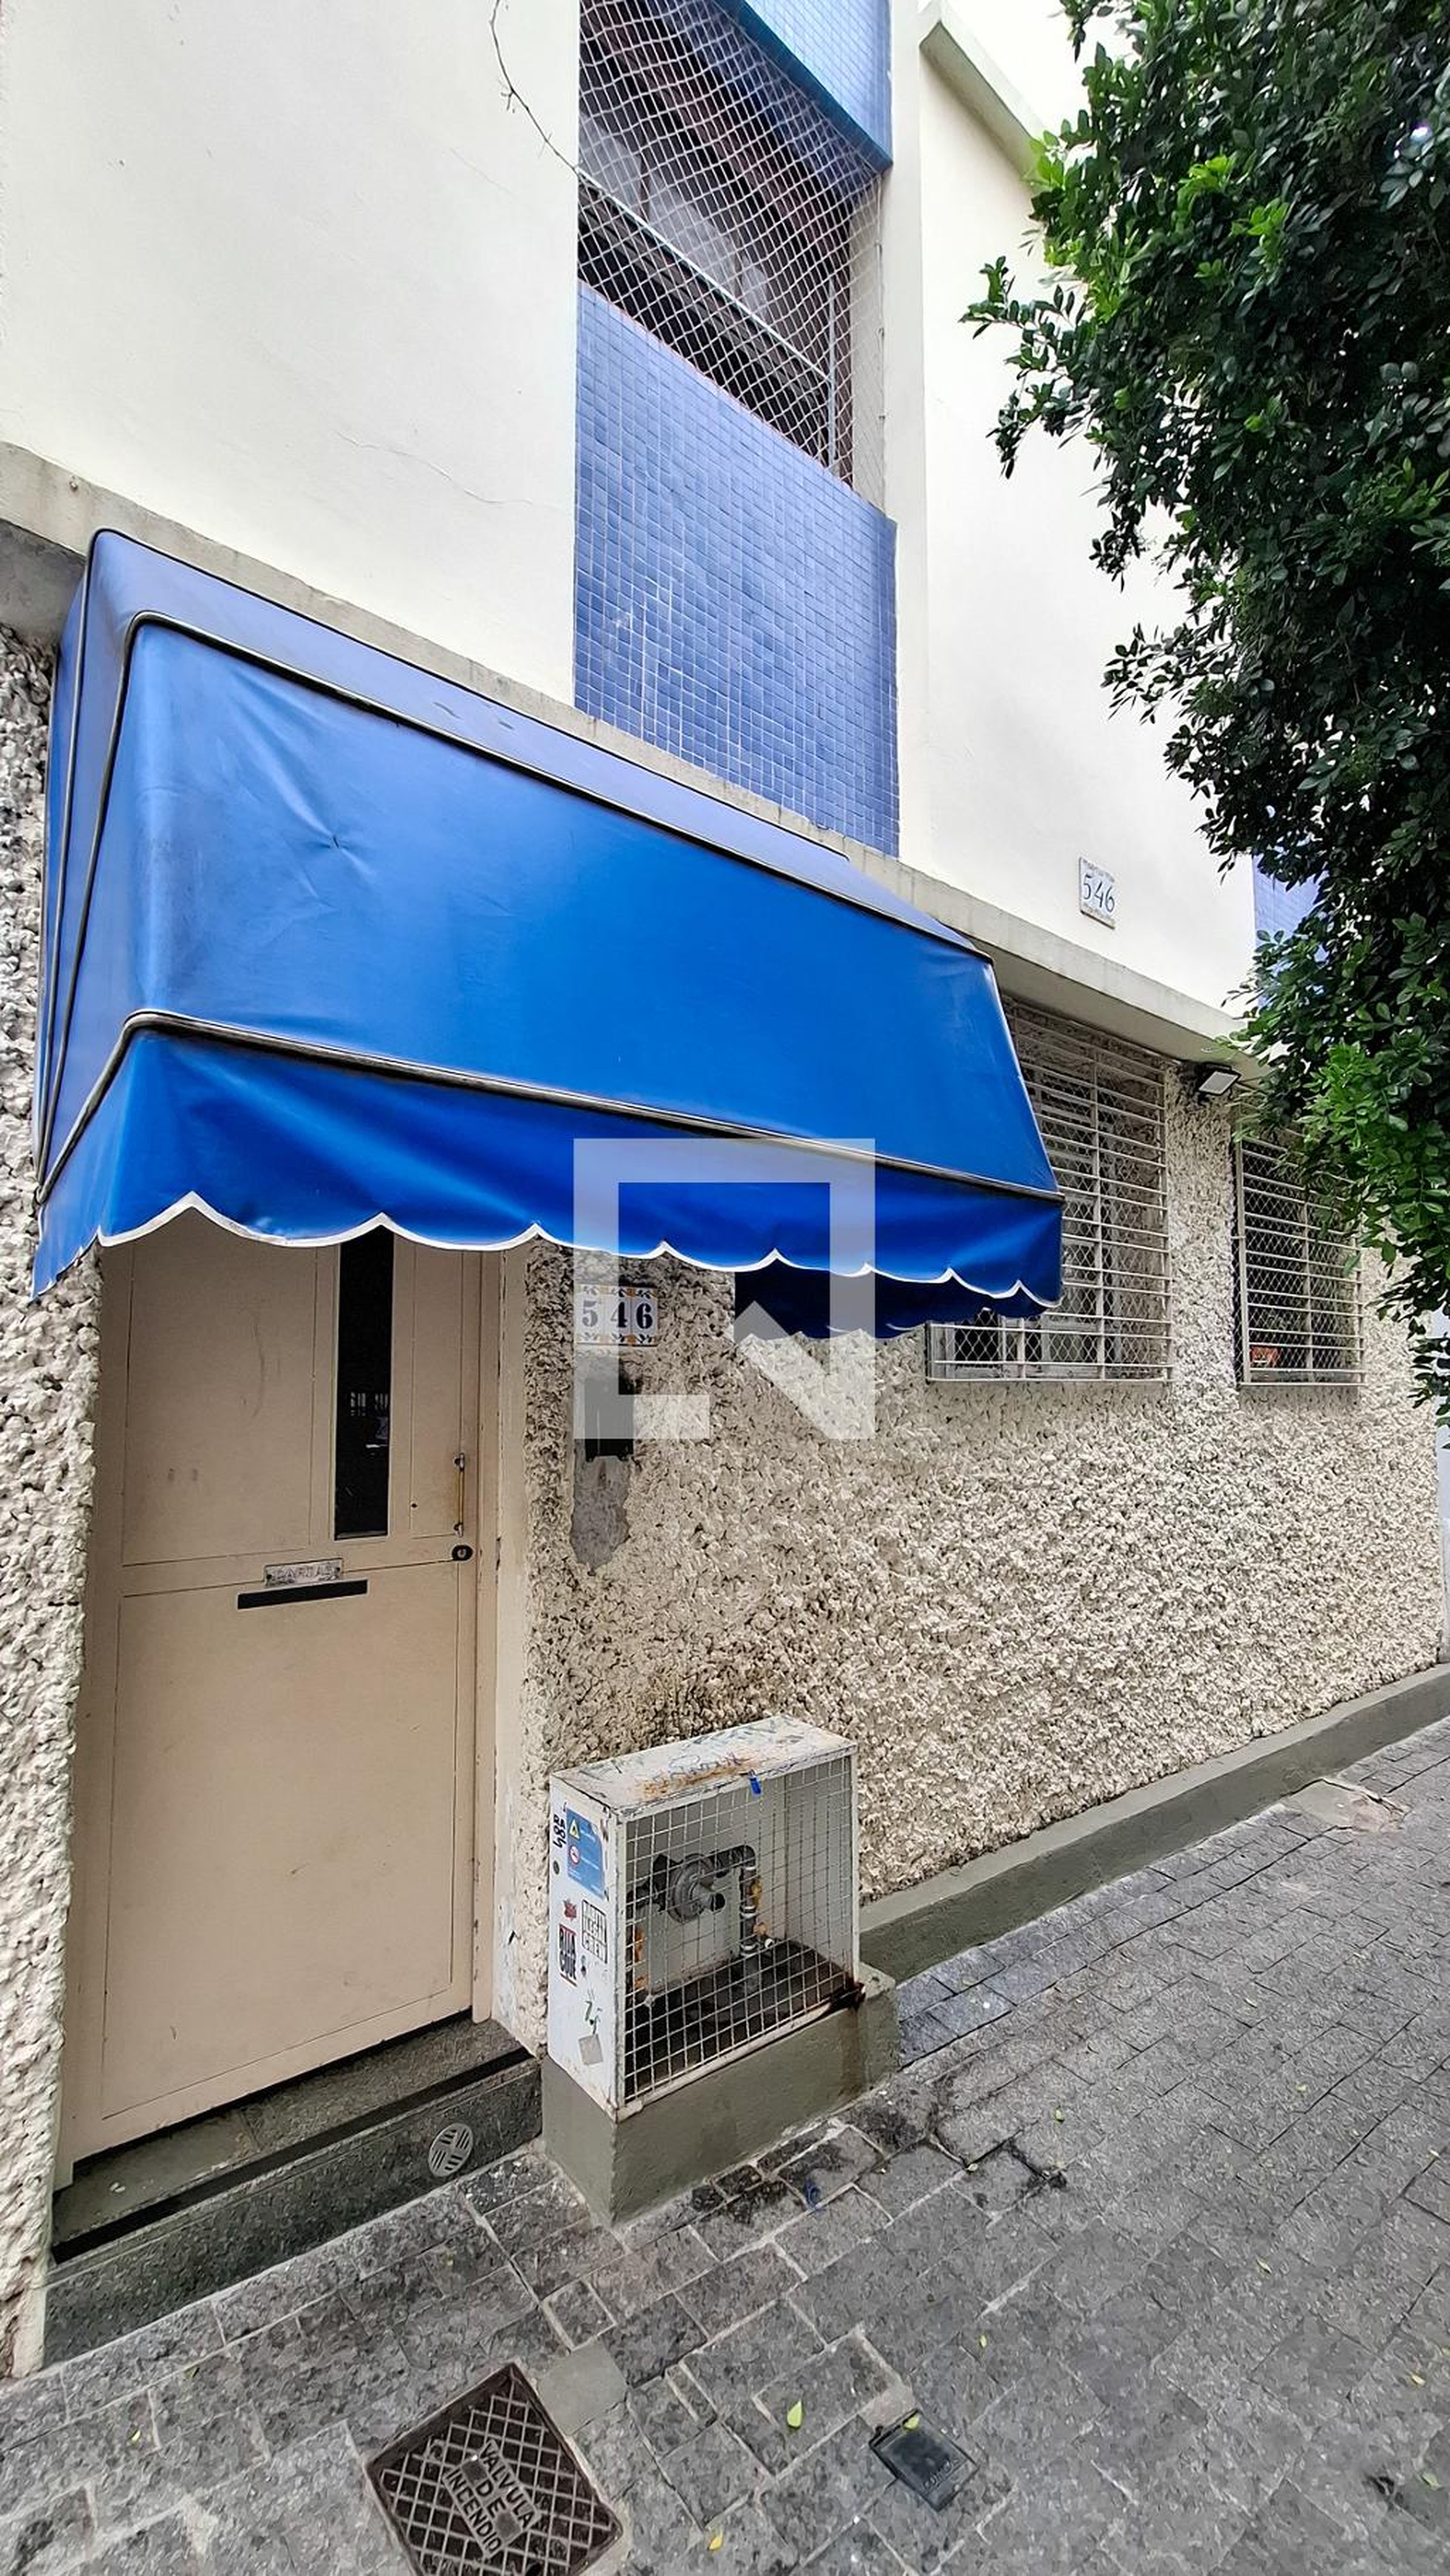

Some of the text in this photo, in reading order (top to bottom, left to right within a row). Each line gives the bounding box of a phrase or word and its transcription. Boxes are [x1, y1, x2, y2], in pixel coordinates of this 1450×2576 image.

[1083, 874, 1115, 912] 546
[582, 1300, 653, 1329] 546
[476, 2479, 506, 2518] DE
[480, 2443, 534, 2528] VALVULA
[446, 2468, 502, 2550] INCENDIO
